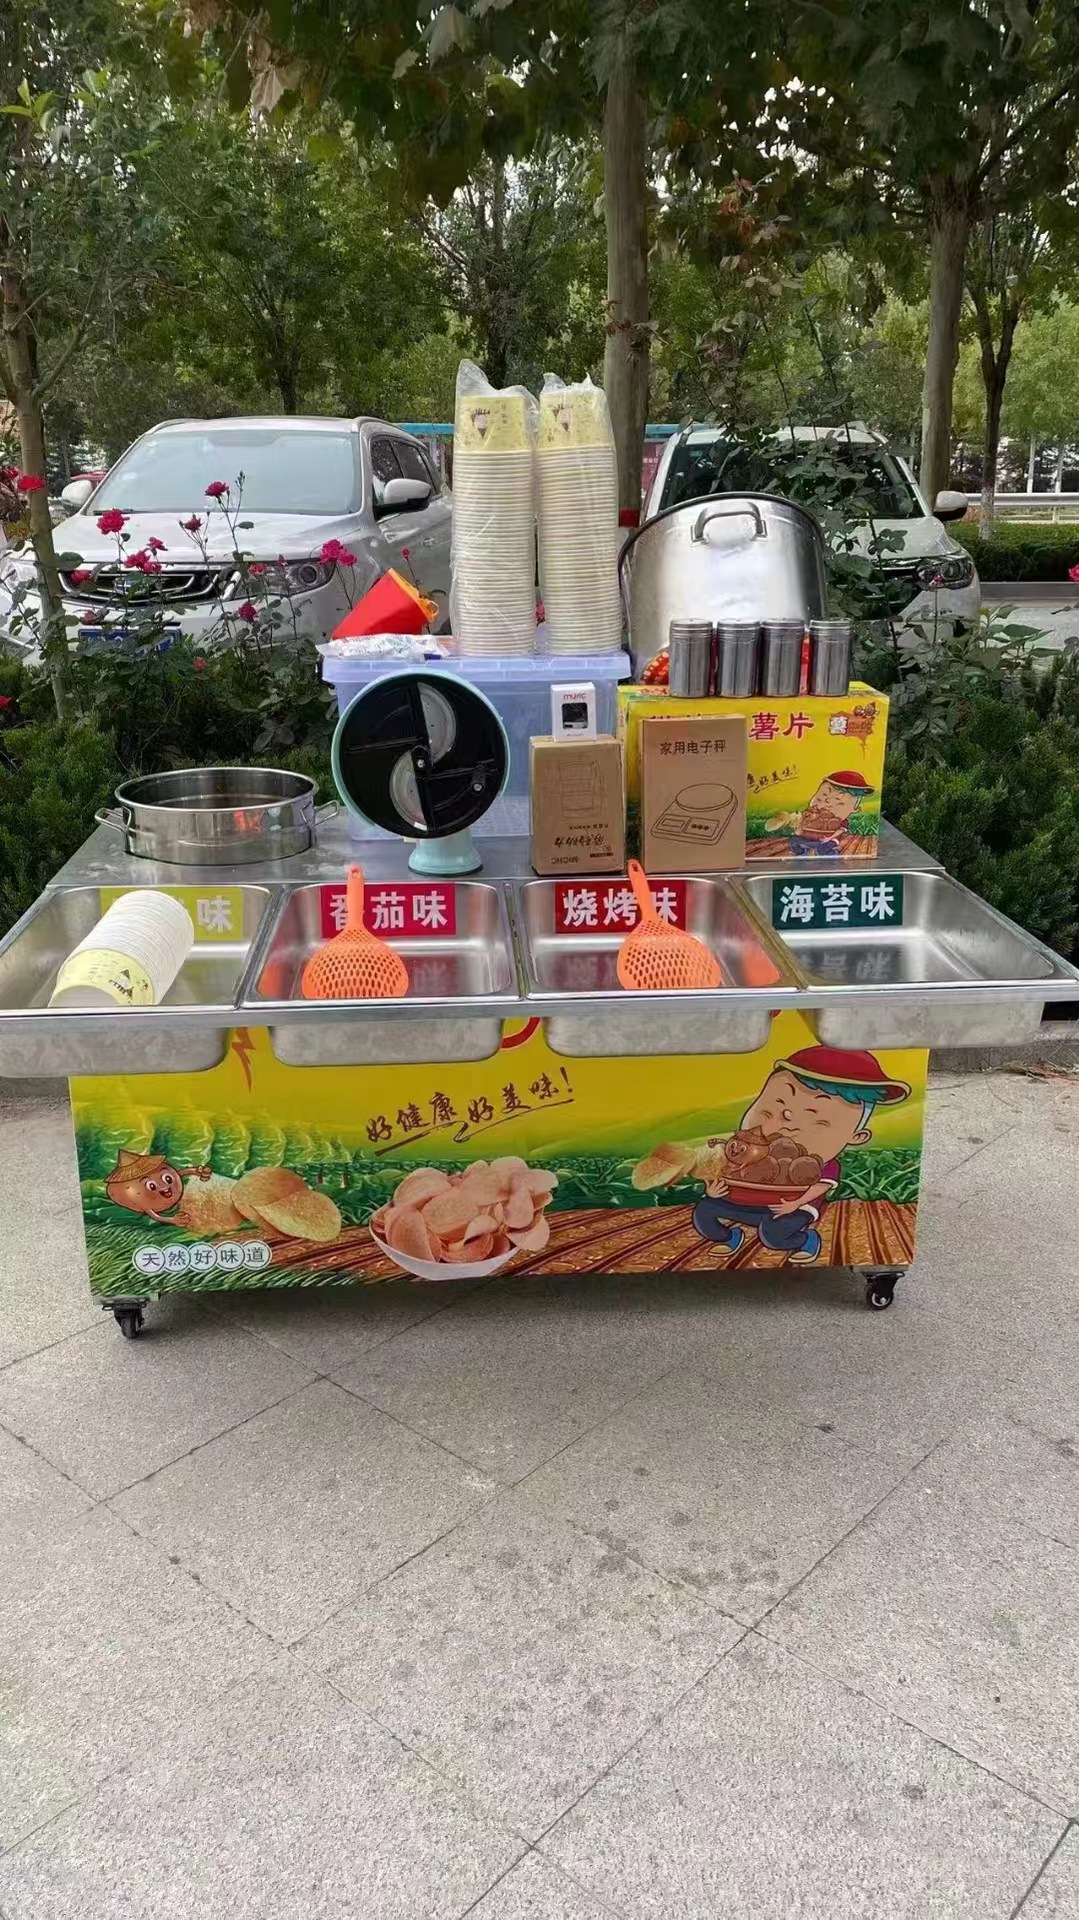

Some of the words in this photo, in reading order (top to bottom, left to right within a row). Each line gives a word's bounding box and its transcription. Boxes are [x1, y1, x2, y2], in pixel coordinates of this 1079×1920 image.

[660, 740, 726, 755] 家用电子秤
[562, 887, 678, 927] 烧烤味
[780, 881, 894, 923] 海苔味
[142, 1247, 266, 1267] 天然好味道
